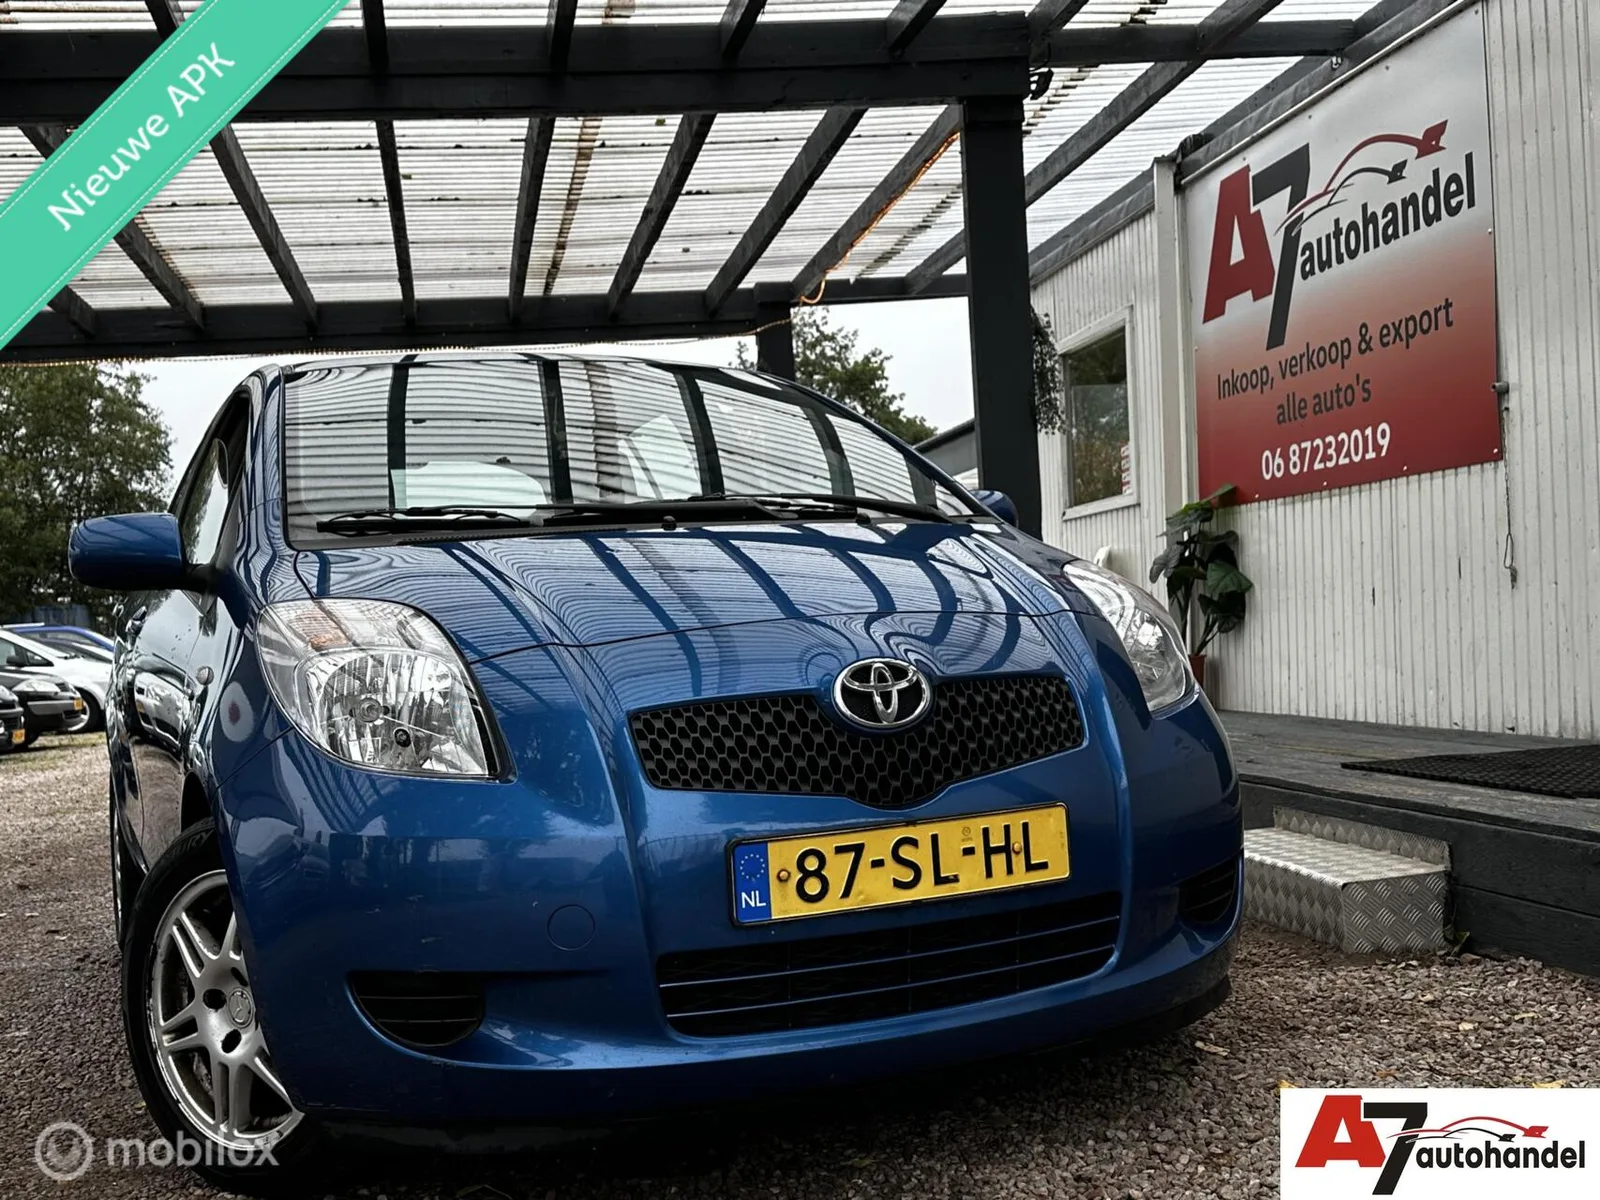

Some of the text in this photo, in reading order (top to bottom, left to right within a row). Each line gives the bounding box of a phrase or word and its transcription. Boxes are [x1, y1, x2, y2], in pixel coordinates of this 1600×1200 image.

[1202, 142, 1311, 351] A7
[1299, 151, 1477, 281] autohandel
[1216, 297, 1455, 400] Inkoop, verkoop & export
[1276, 373, 1373, 426] alle auto's
[1261, 422, 1391, 480] 06 87232019
[740, 890, 767, 909] NL
[795, 819, 1050, 903] 87-SL-HL
